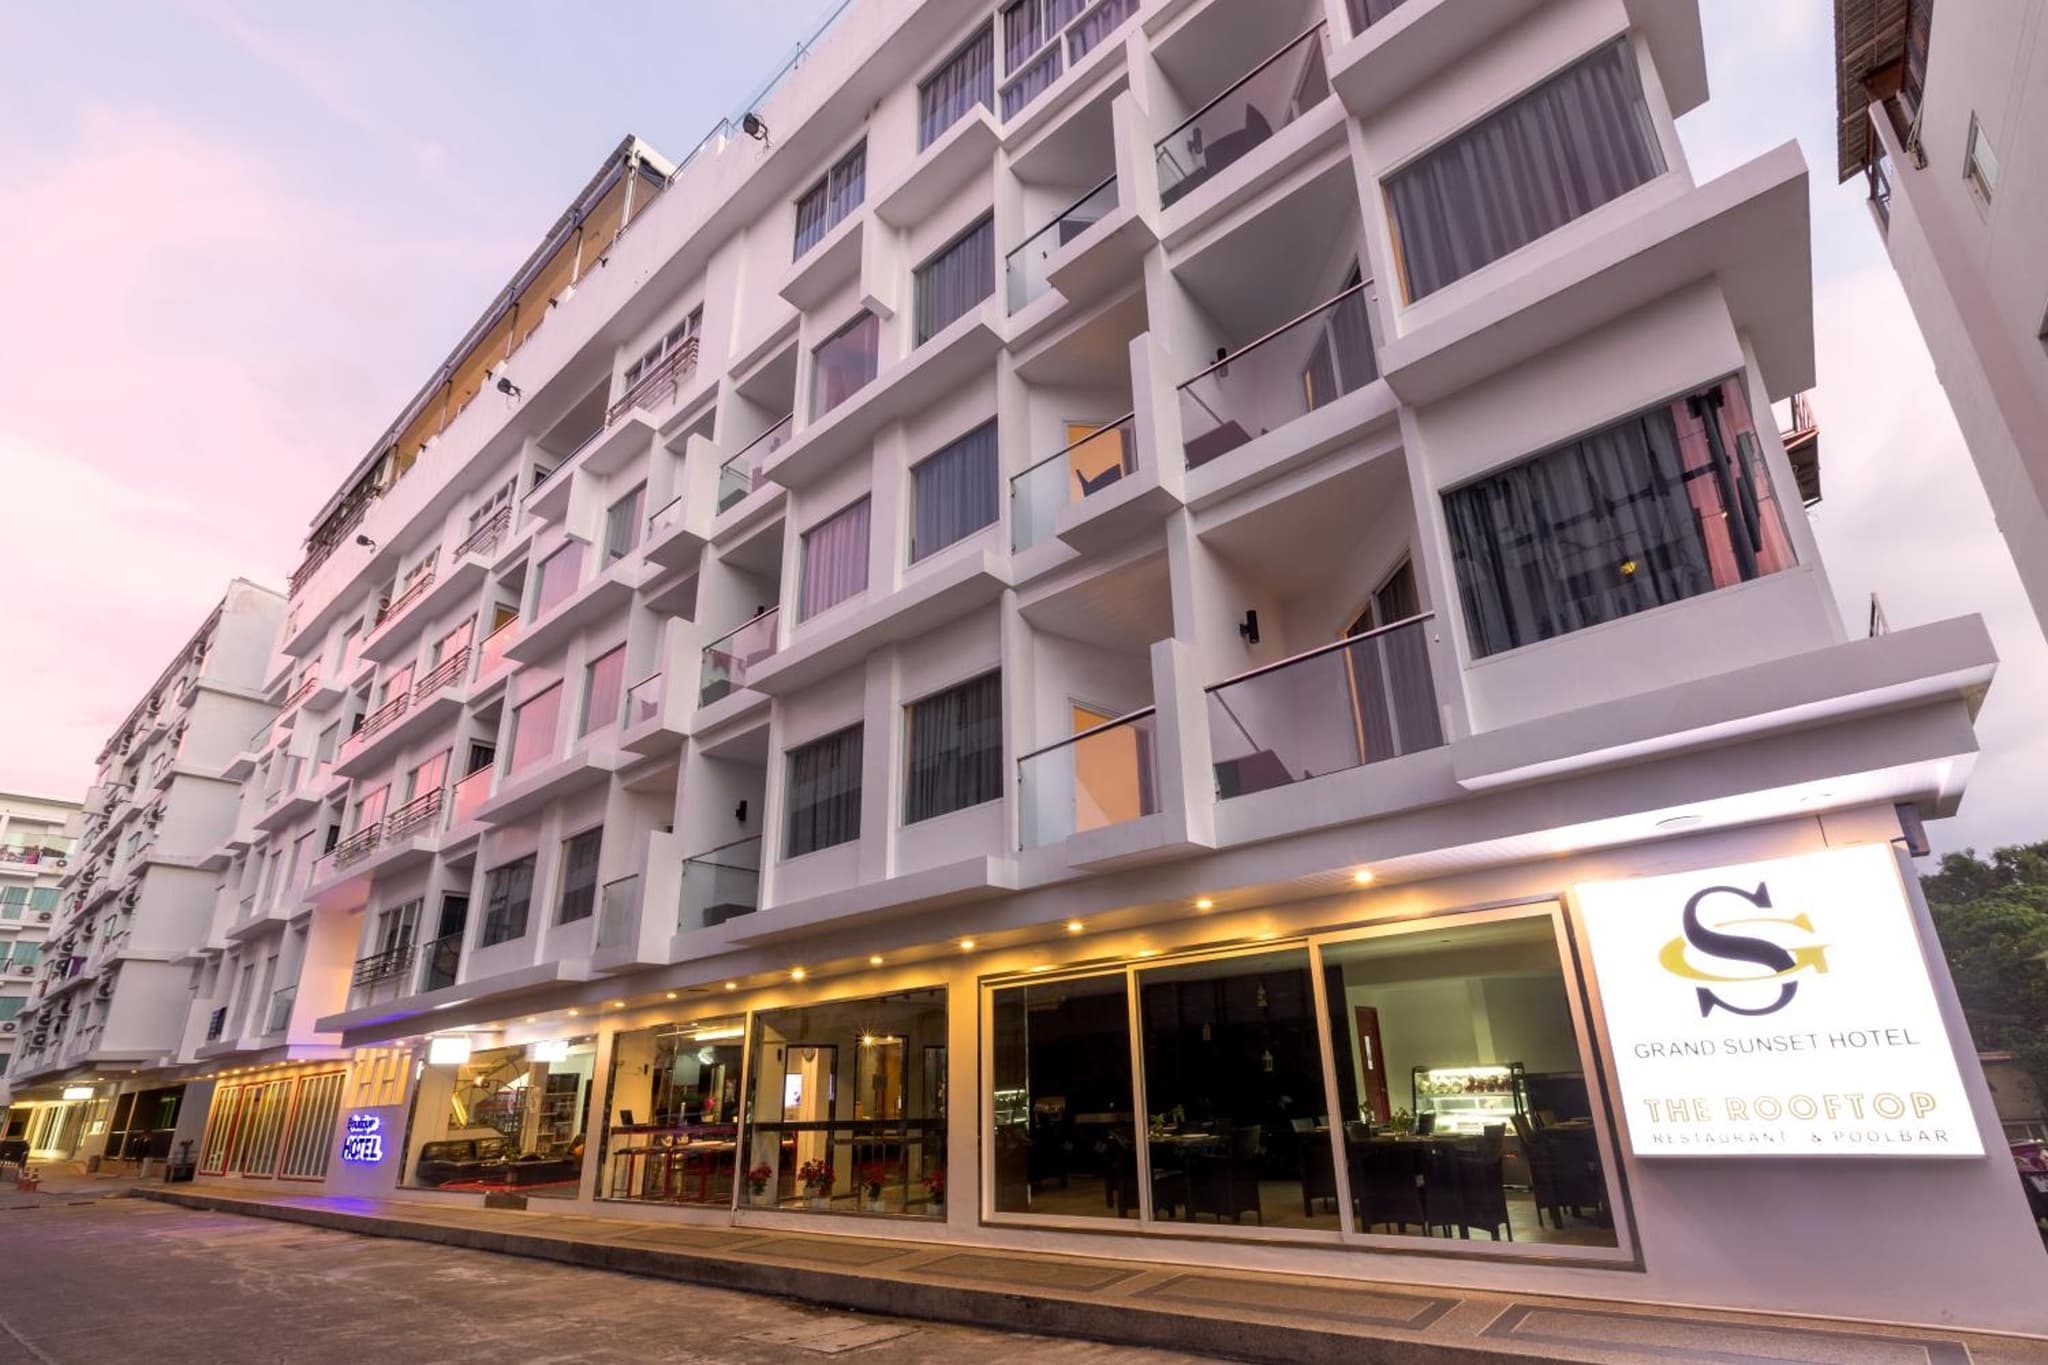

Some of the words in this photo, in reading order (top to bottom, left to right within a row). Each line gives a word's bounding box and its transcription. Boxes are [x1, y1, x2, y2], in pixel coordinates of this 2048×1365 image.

[1634, 1038, 1716, 1059] GRAND
[1724, 1033, 1817, 1055] SUNSET
[1829, 1028, 1921, 1048] HOTEL
[1643, 1097, 1711, 1123] THE
[1725, 1092, 1937, 1121] ROOFTOP
[342, 1135, 382, 1161] HOTEL
[1810, 1130, 1823, 1143] &
[1832, 1129, 1949, 1144] POOLBAR
